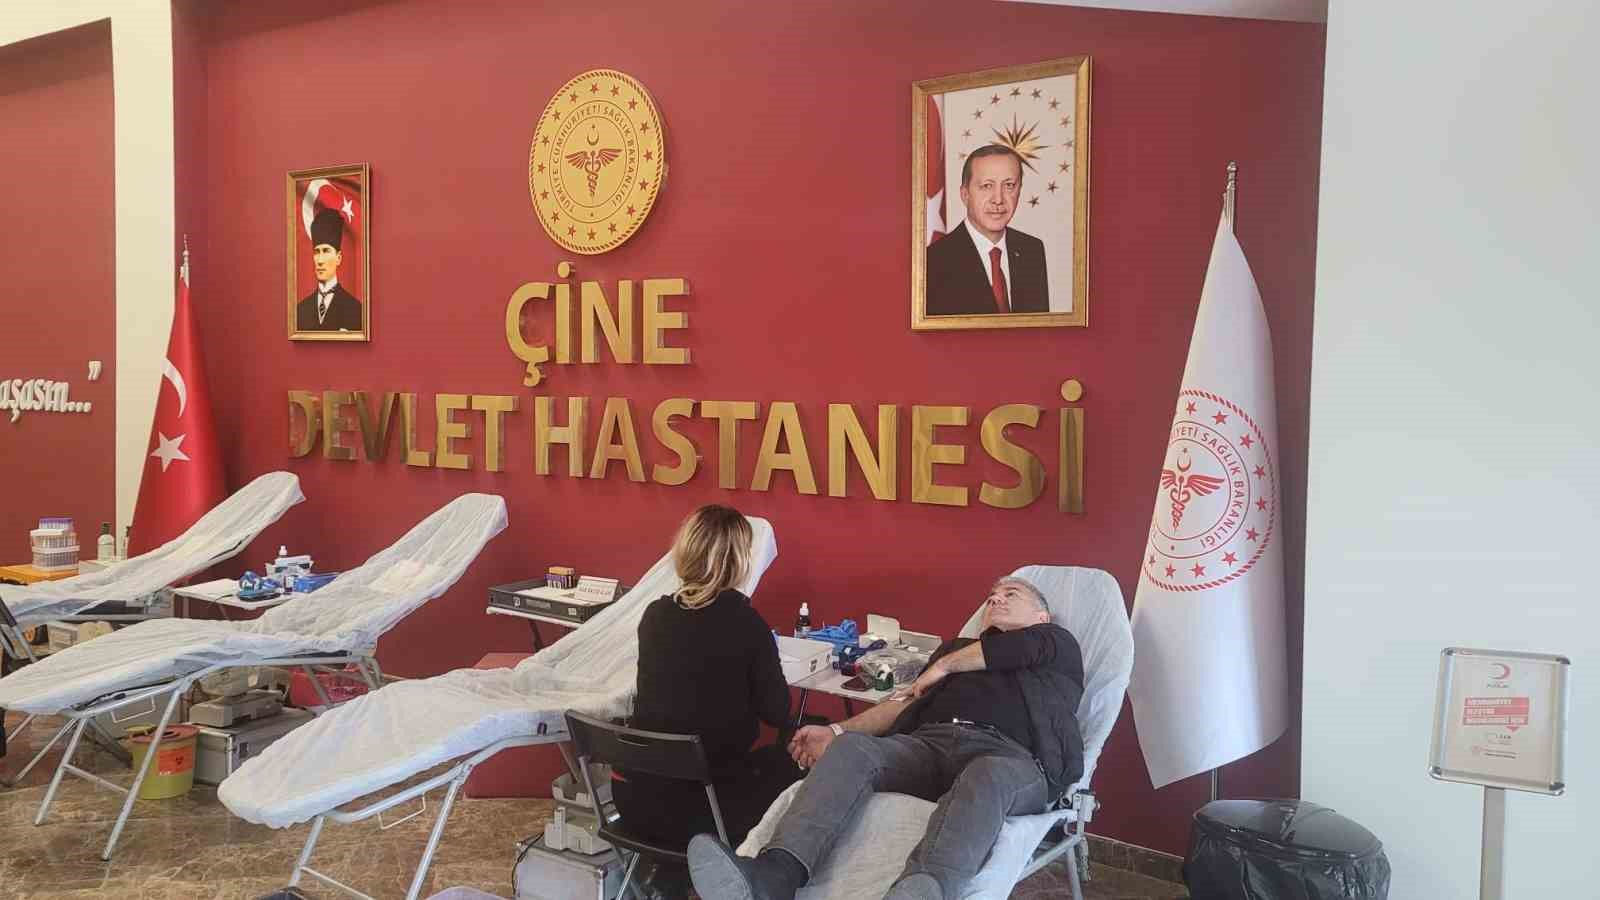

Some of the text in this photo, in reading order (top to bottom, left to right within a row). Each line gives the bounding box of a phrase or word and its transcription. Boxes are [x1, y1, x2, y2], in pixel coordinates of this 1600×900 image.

[505, 261, 691, 388] ÇİNE
[287, 379, 1085, 514] DEVLET HASTANESİ
[1201, 432, 1241, 476] SAĞLIK
[1199, 480, 1246, 548] BAKANLIĞI
